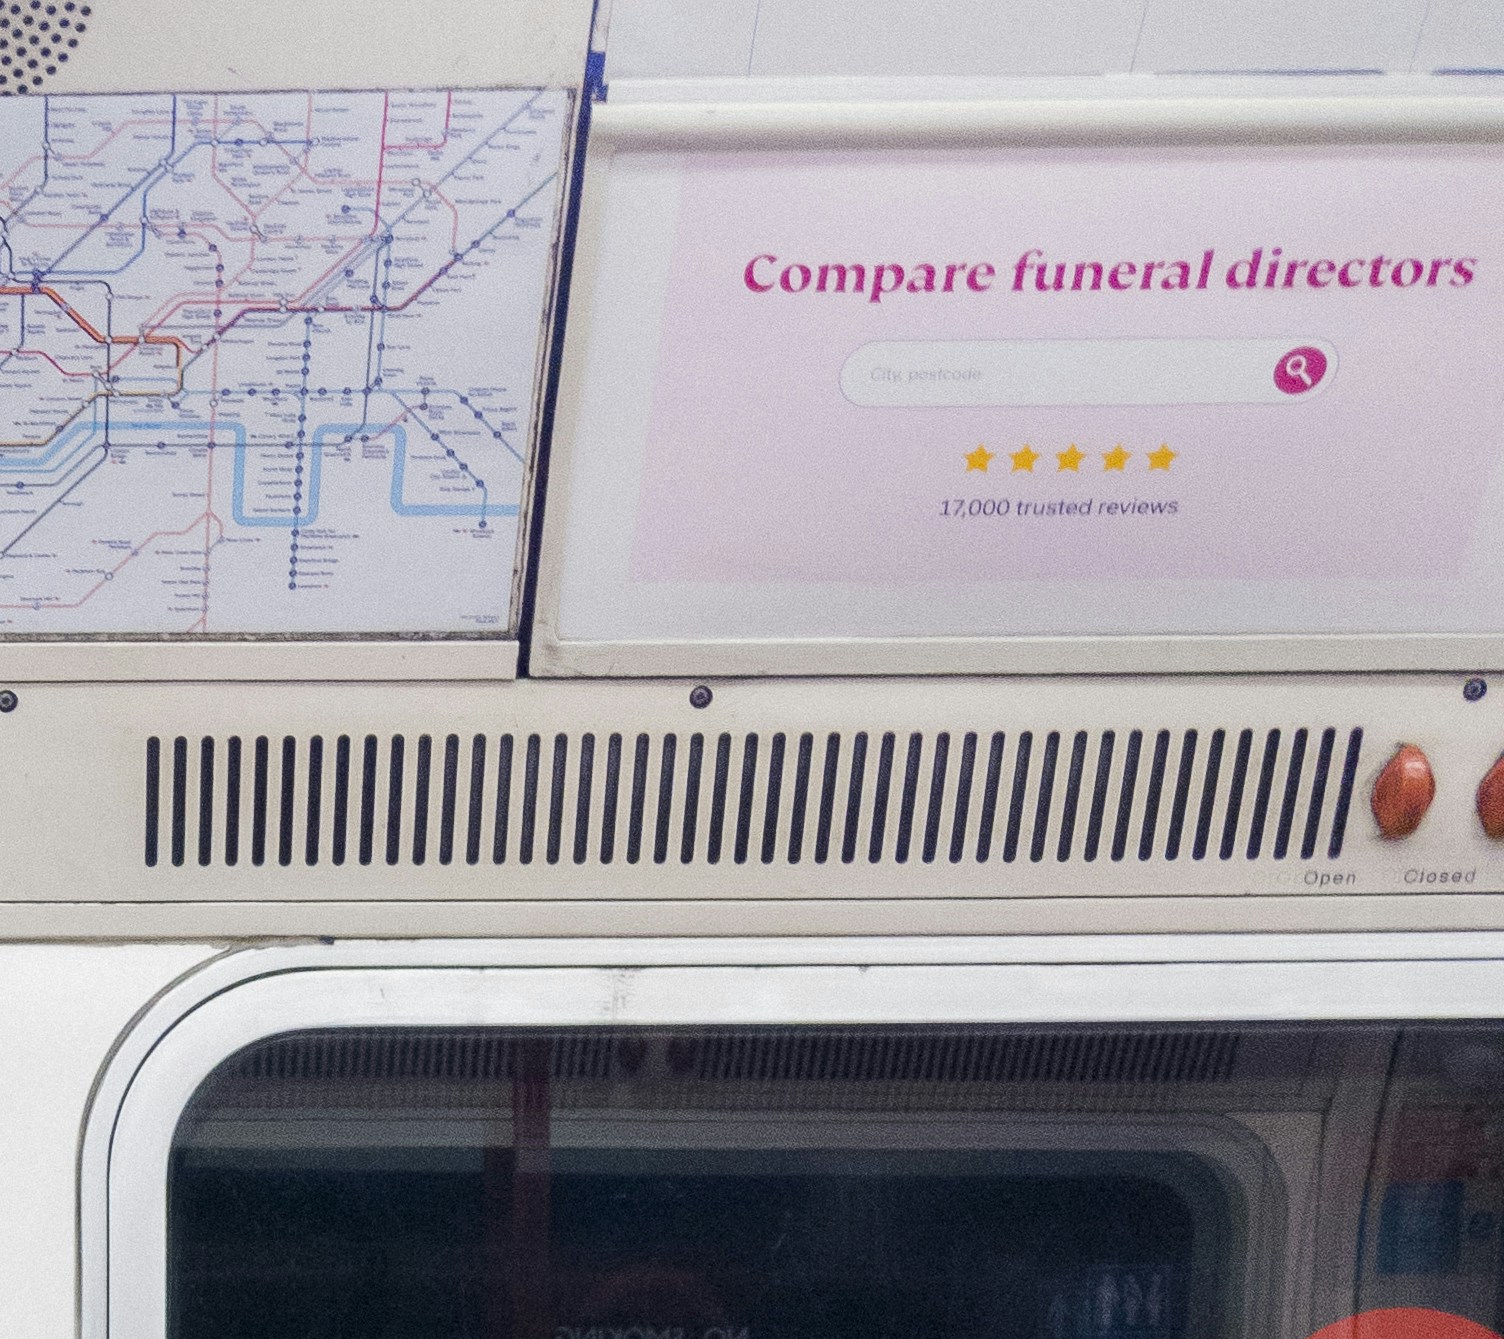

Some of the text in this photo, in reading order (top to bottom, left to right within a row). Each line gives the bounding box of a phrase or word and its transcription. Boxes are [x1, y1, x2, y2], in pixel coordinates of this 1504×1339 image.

[743, 246, 1480, 303] Compare funeral directors
[938, 497, 1180, 519] 17,000 trusted reviews
[1303, 869, 1357, 888] Open
[1403, 867, 1477, 884] Closed
